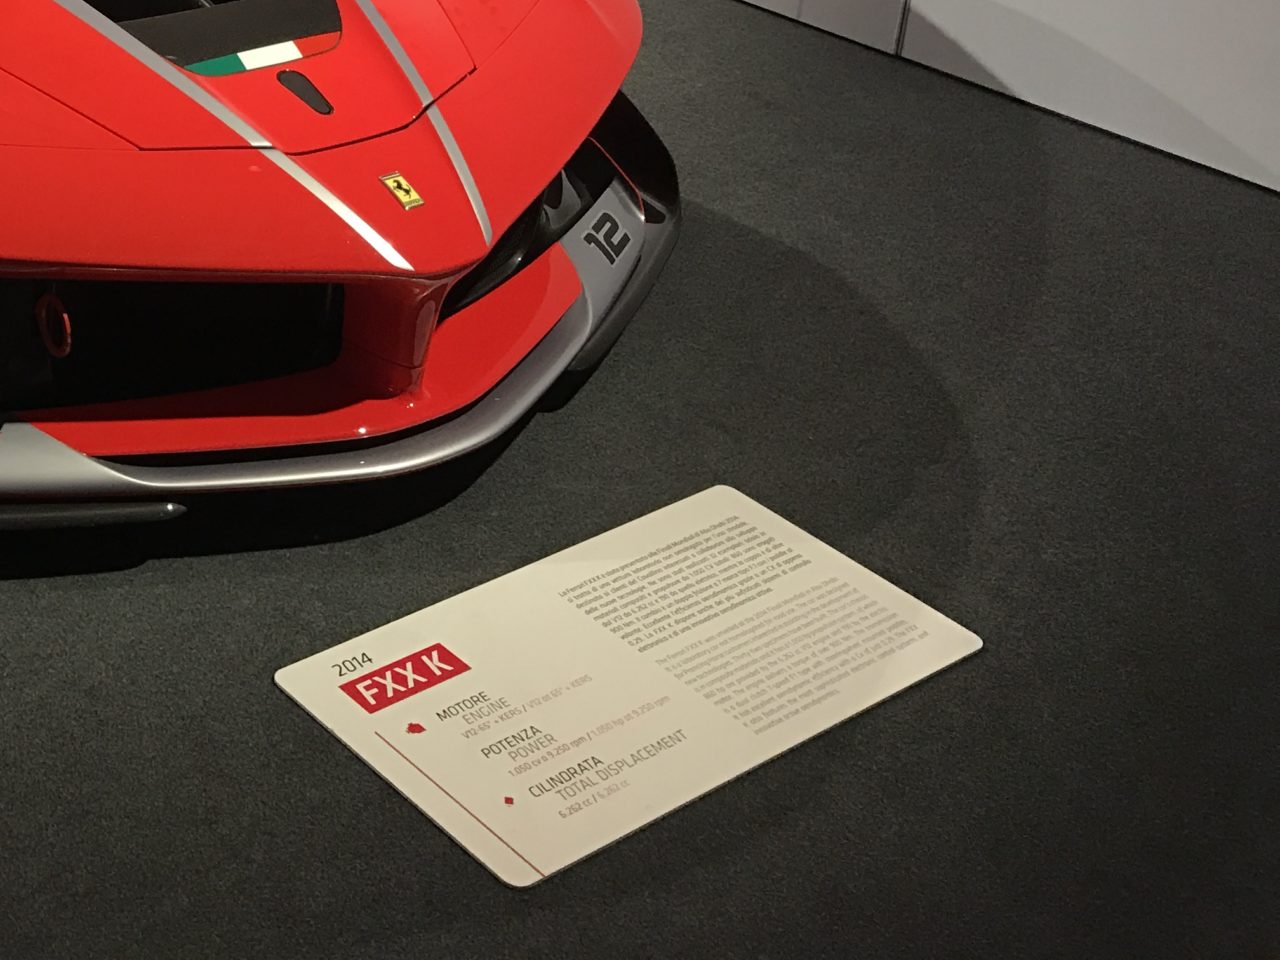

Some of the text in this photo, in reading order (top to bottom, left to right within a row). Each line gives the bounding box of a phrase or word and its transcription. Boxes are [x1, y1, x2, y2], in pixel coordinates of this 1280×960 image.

[583, 212, 631, 265] 12
[331, 652, 374, 677] 2014
[354, 649, 454, 705] FXX K
[435, 690, 491, 721] MOTORE
[461, 696, 511, 725] ENGINE
[480, 724, 542, 759] POTENZA
[507, 732, 558, 762] POWER
[527, 754, 603, 798] CILINDRATA
[555, 728, 688, 801] TOTAL DISPLACEMENT
